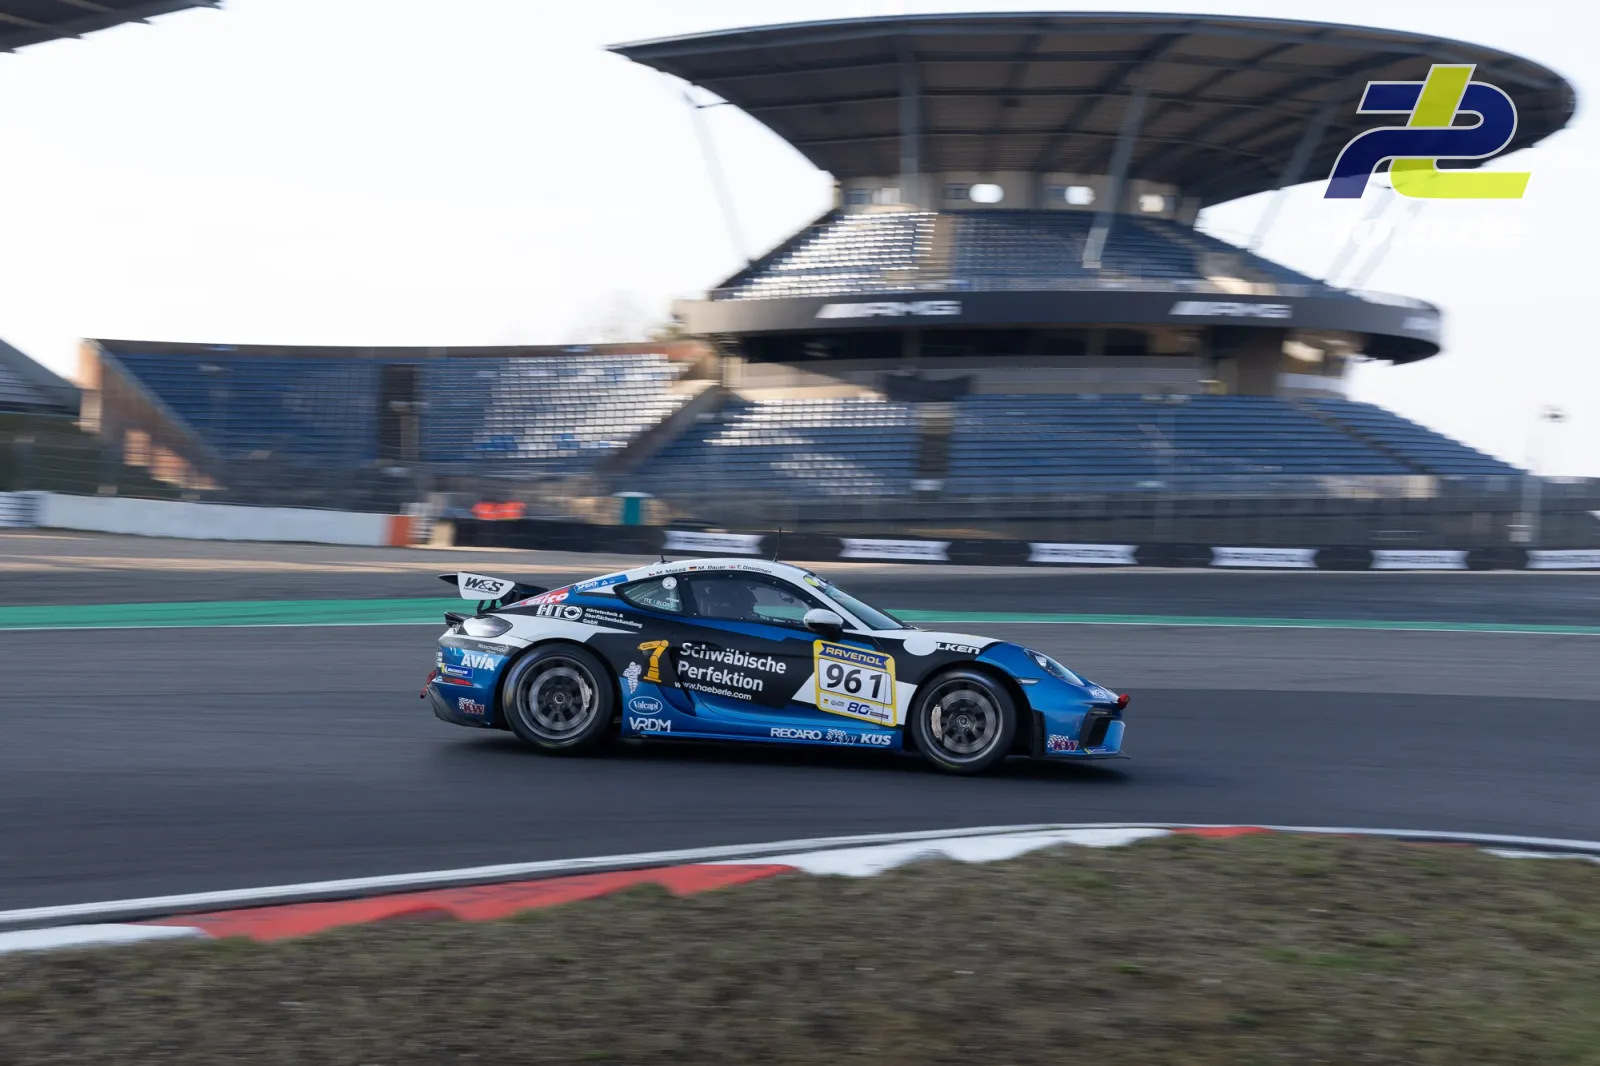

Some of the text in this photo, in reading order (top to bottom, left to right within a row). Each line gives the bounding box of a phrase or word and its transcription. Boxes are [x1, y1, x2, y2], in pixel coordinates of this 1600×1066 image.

[464, 577, 505, 592] W&S
[679, 641, 787, 674] Schwäbische
[825, 646, 883, 666] RAVENOL
[677, 660, 764, 692] Perfektion
[826, 663, 883, 699] 961
[674, 681, 752, 701] www.haeberle.com
[629, 716, 672, 733] VRDM
[770, 728, 822, 741] RECARO
[860, 733, 893, 746] KÜS
